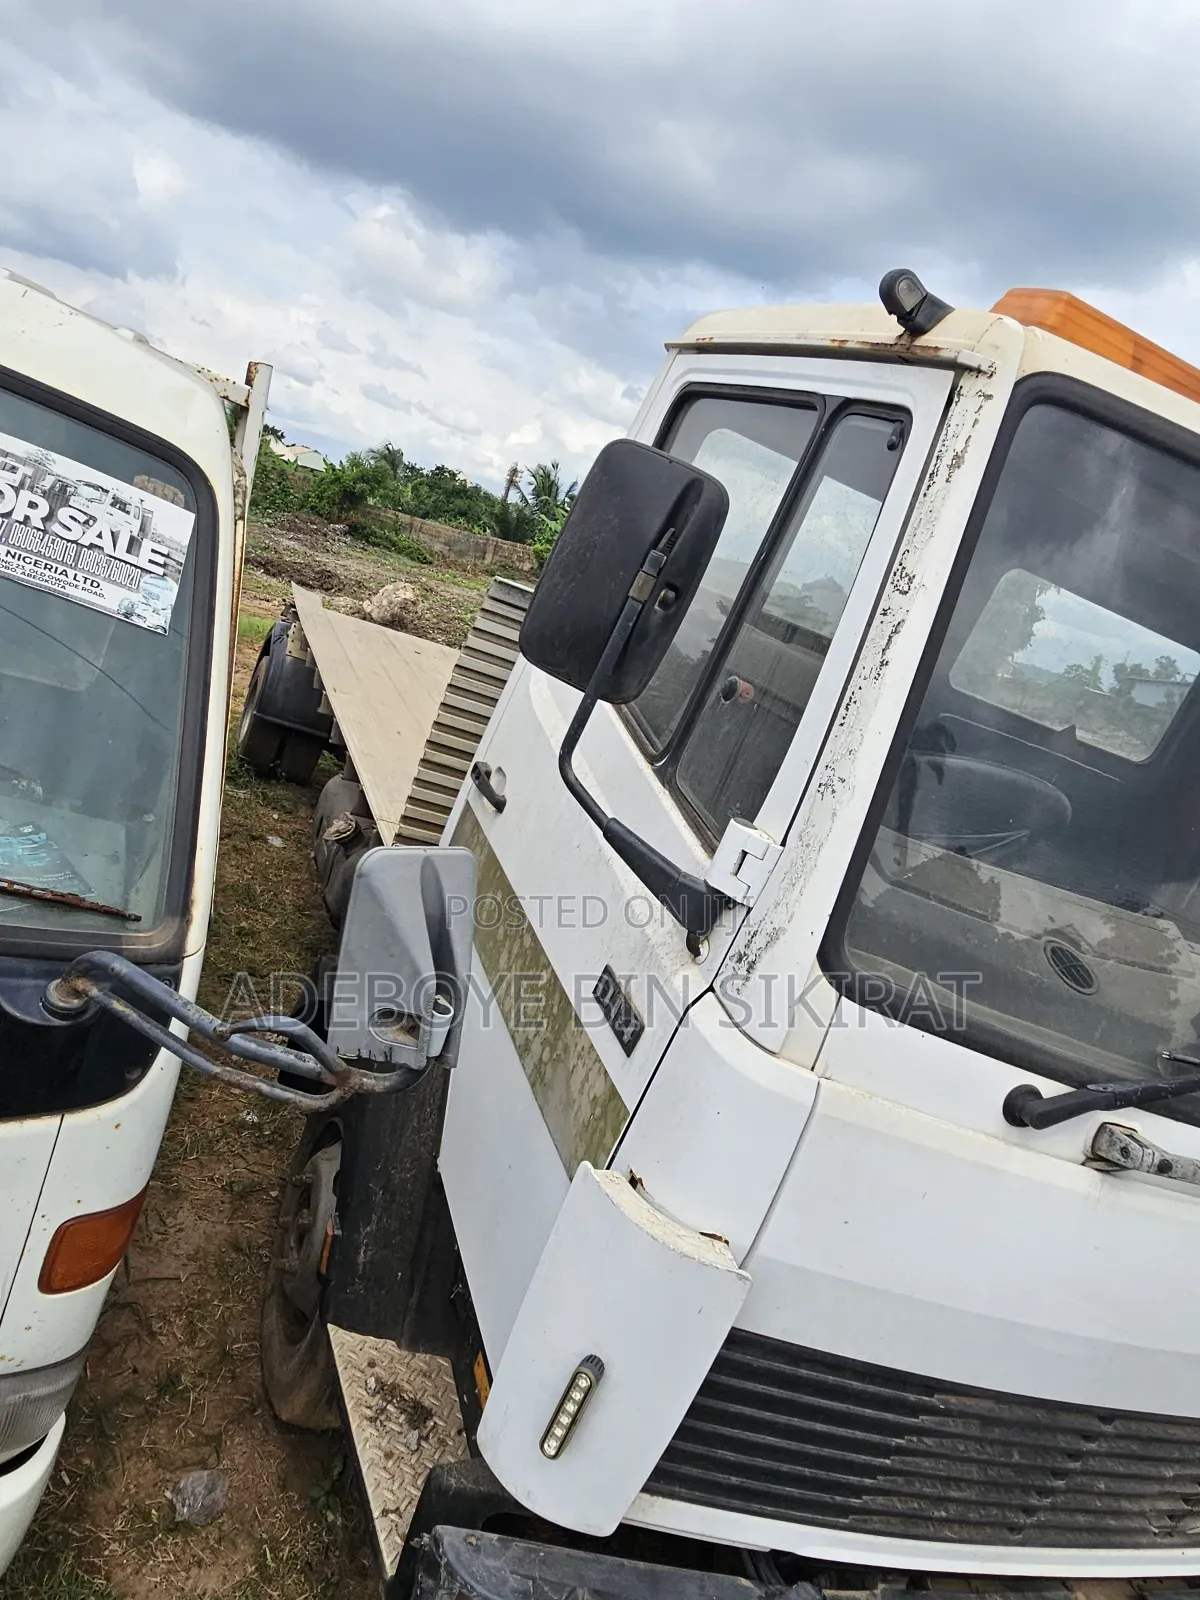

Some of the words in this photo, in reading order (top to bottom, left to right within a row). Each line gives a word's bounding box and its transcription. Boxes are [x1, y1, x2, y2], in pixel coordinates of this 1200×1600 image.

[8, 522, 77, 567] 08066459019,
[78, 548, 141, 589] 08035760020
[51, 507, 169, 577] SALE
[5, 550, 69, 579] NIGERIA
[72, 573, 103, 591] LTD.
[20, 571, 67, 590] ABEOKUTA
[29, 568, 46, 578] OLD
[47, 574, 80, 590] OWODE
